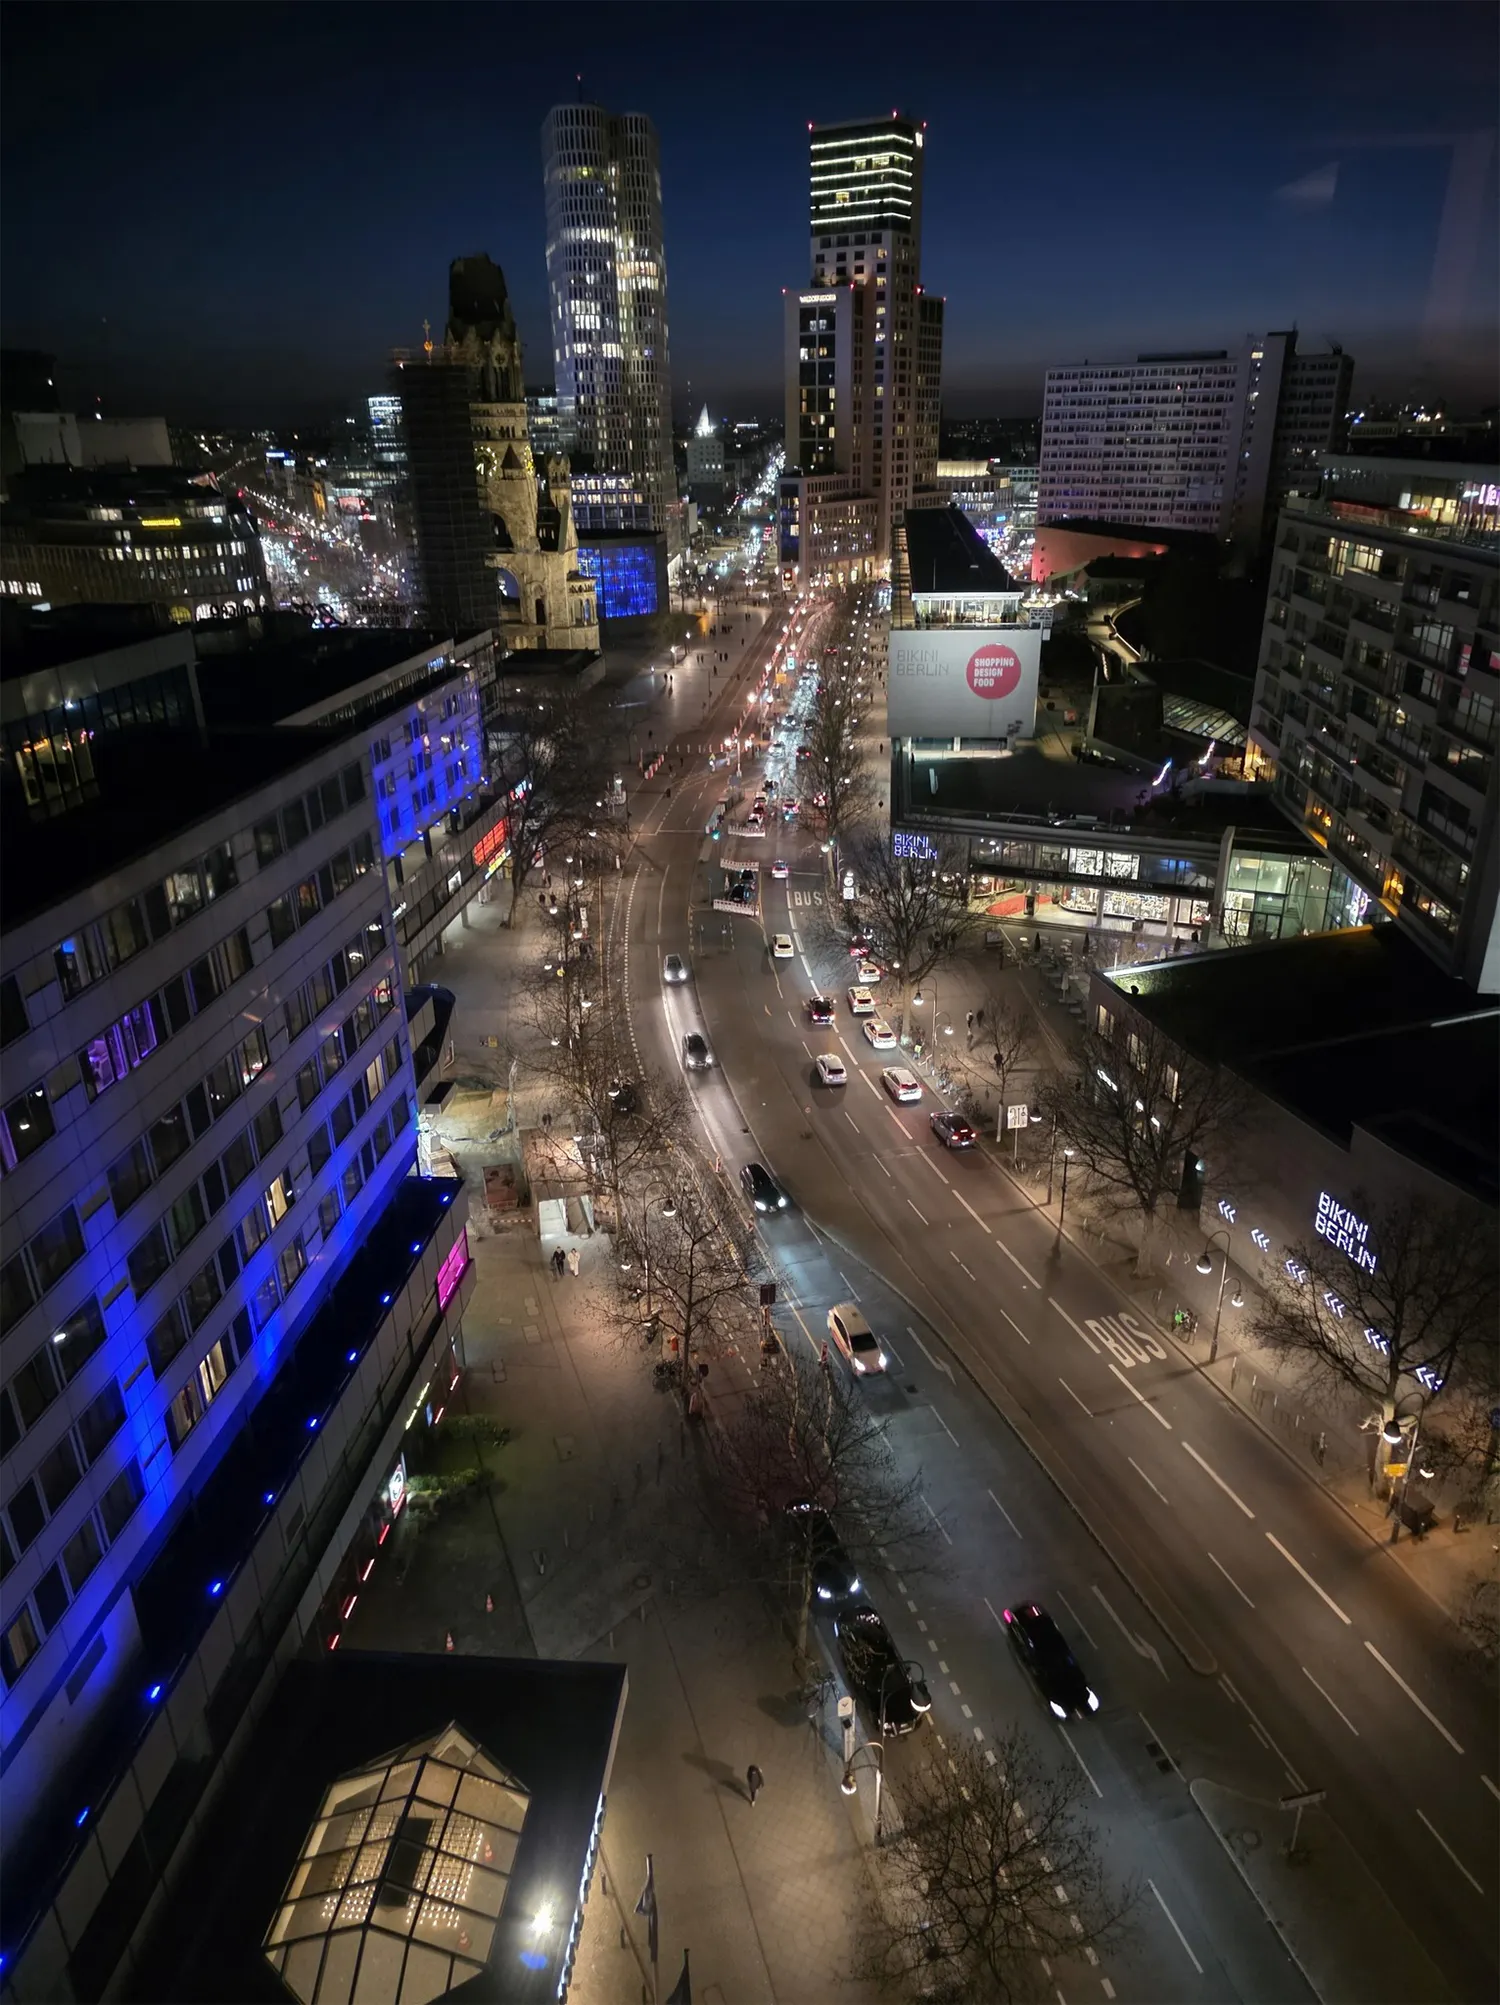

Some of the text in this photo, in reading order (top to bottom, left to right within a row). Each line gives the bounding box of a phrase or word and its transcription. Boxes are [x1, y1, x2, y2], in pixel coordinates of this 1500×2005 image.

[896, 650, 939, 663] BIKINI
[974, 658, 1015, 668] SHOPPING
[896, 663, 949, 677] BERLIN
[974, 668, 1003, 677] DESIGN
[974, 678, 995, 687] FOOD
[894, 833, 929, 848] BIKINI
[894, 845, 938, 861] BERLIN
[794, 891, 823, 906] BUS
[1317, 1191, 1369, 1243] BIKINI
[1314, 1211, 1378, 1275] BERLIN
[1084, 1312, 1167, 1368] BUS
